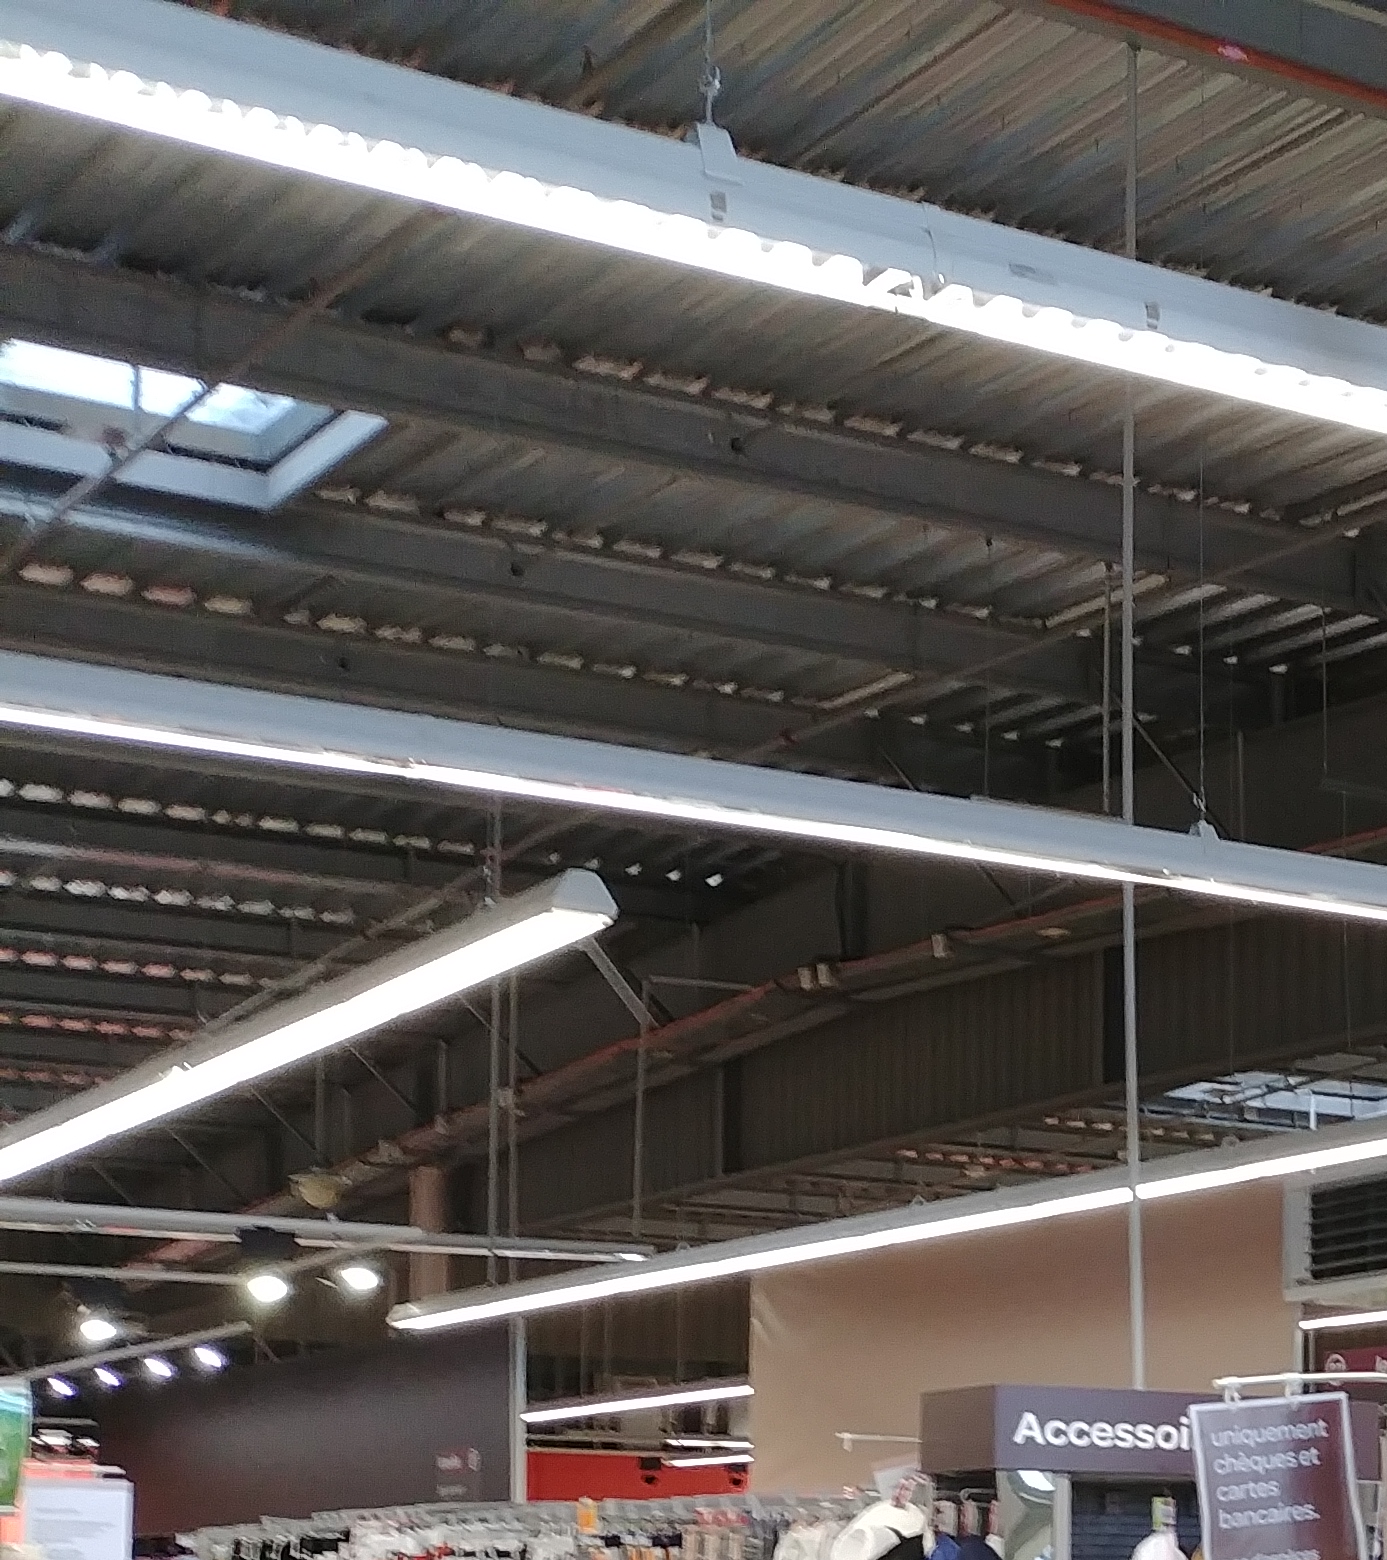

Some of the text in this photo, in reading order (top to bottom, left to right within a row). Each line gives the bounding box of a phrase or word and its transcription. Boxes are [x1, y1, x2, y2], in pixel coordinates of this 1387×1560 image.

[1013, 1411, 1190, 1450] Accessoi
[1211, 1418, 1329, 1447] uniquement
[1213, 1447, 1321, 1476] chèques et
[1216, 1479, 1281, 1501] cartes
